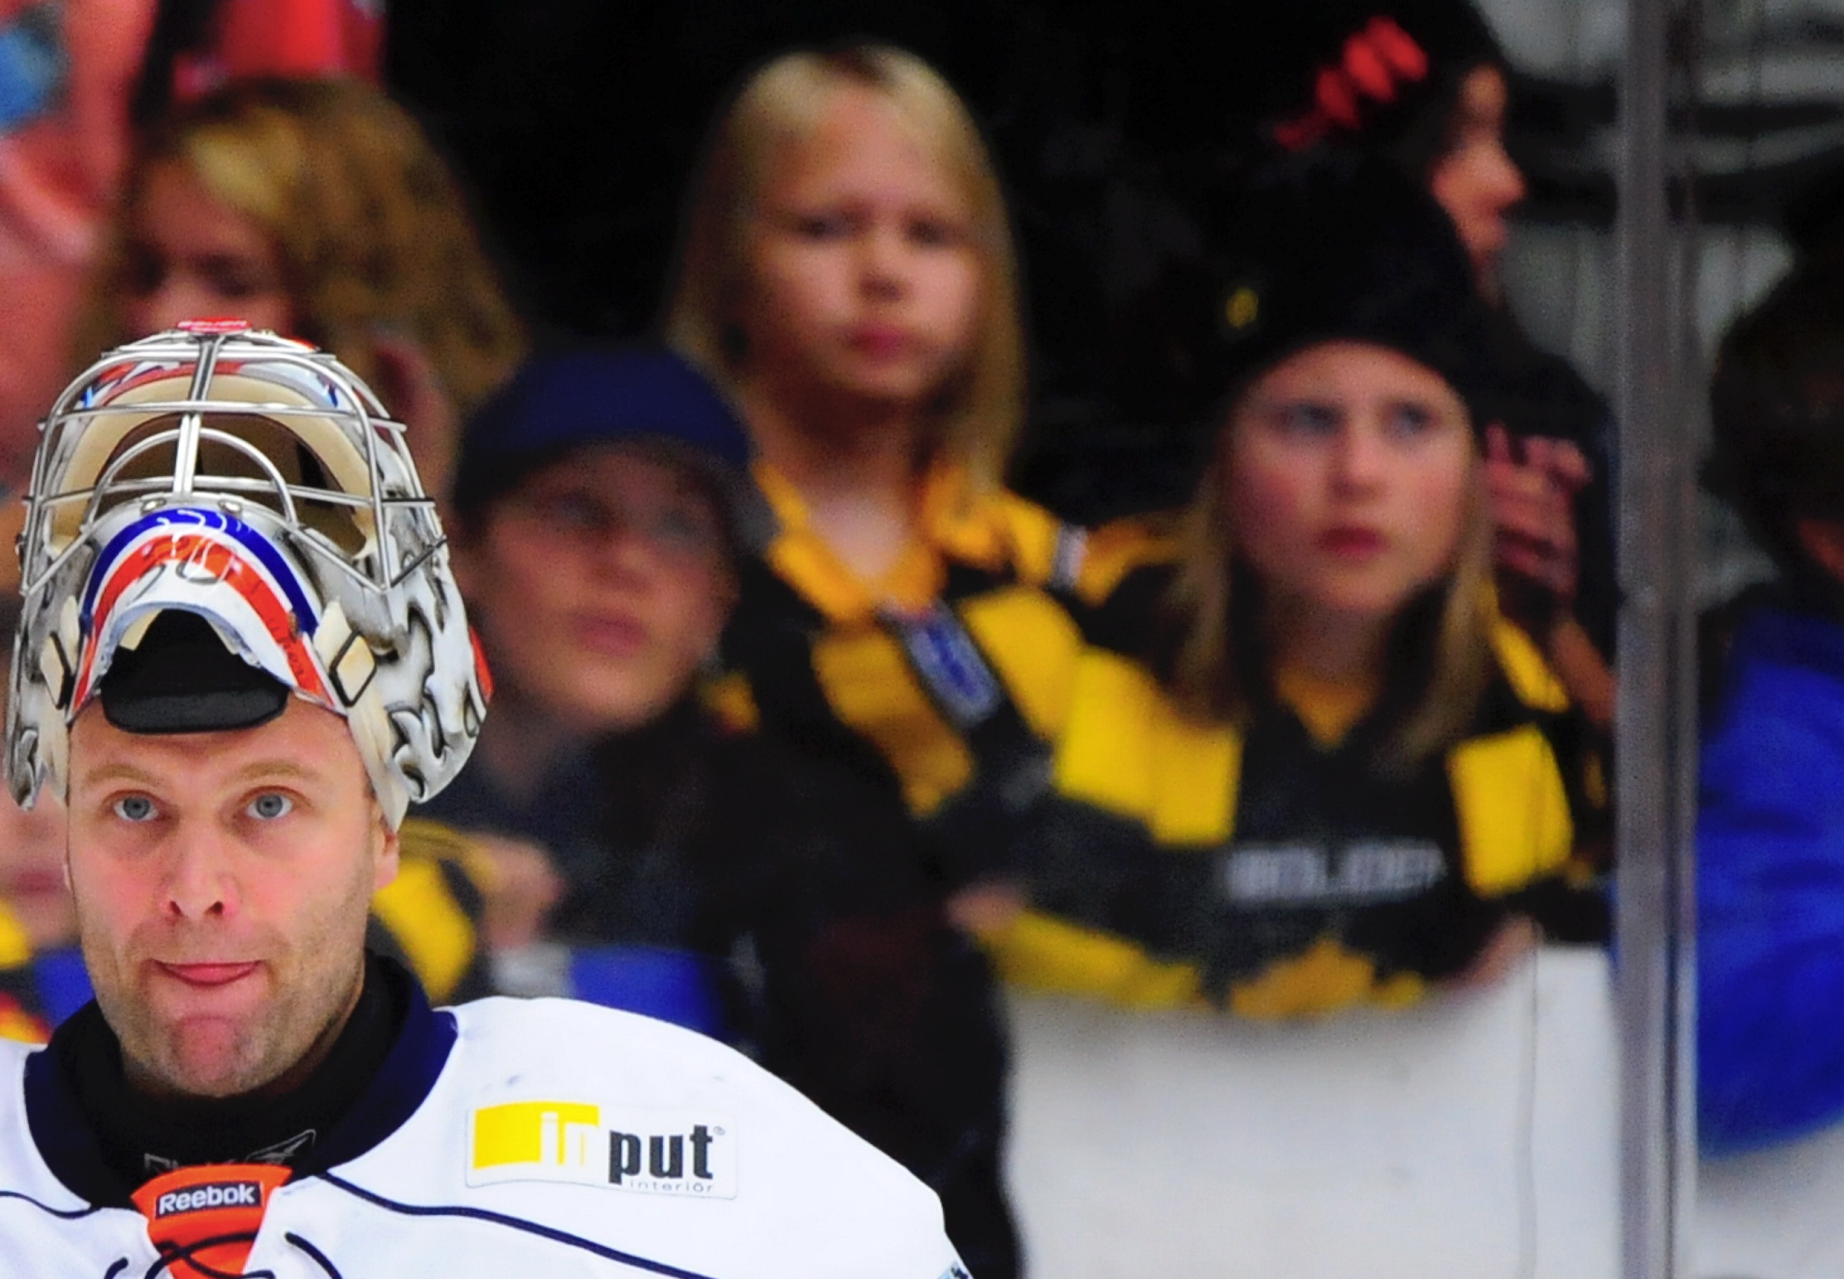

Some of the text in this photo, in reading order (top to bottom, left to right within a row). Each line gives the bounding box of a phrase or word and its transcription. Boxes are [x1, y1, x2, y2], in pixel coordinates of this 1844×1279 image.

[537, 1110, 714, 1186] input
[158, 1183, 256, 1216] Reebok
[629, 1181, 714, 1194] interiör
